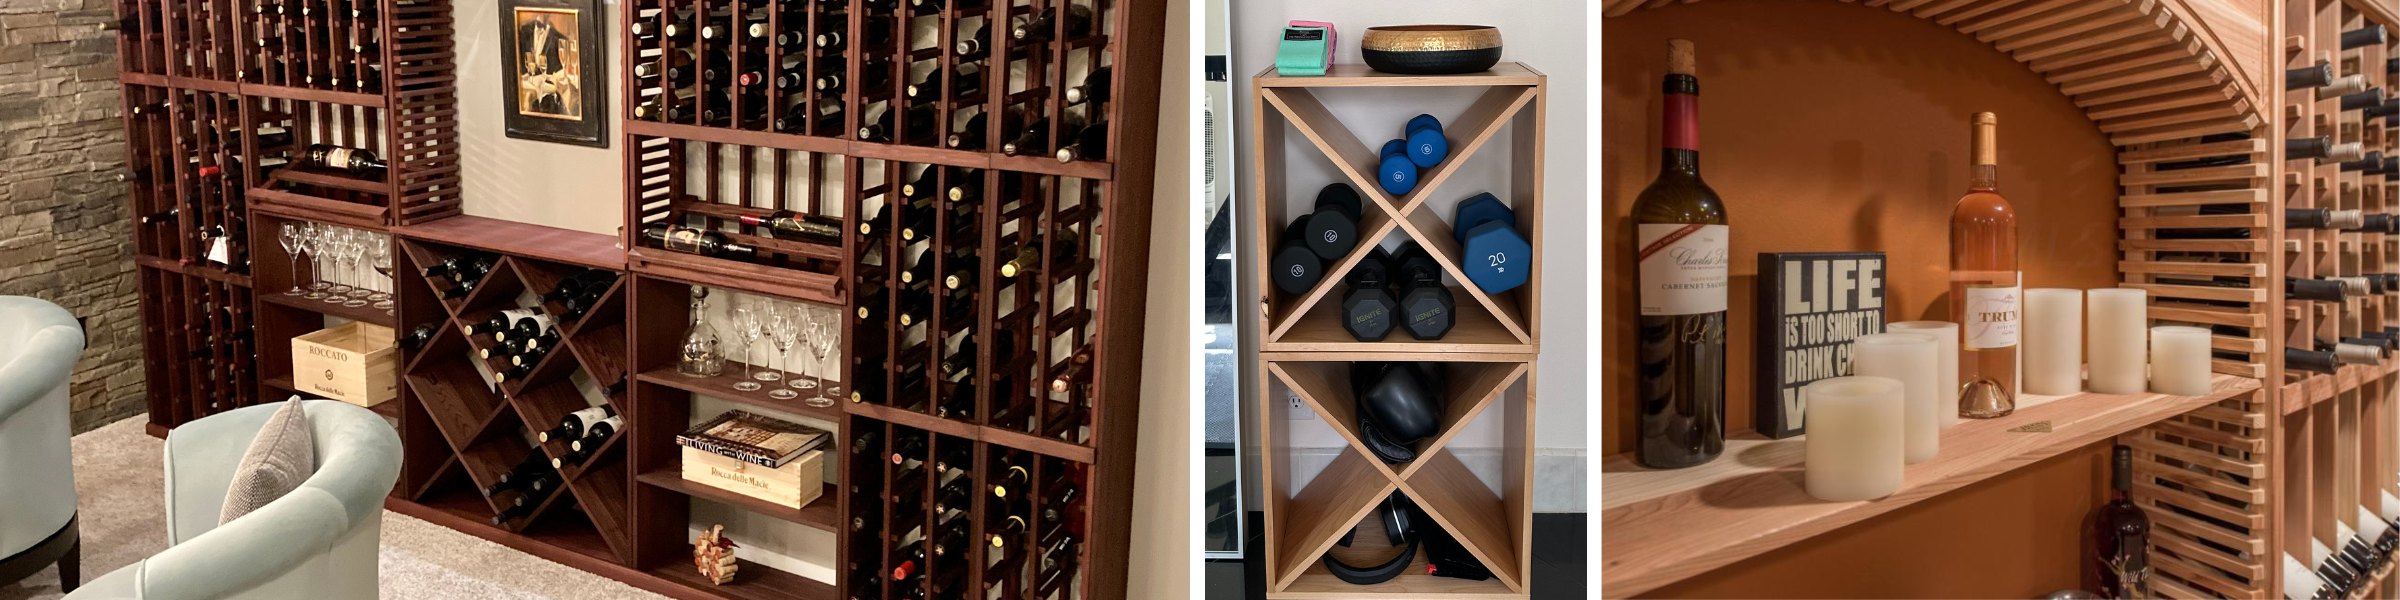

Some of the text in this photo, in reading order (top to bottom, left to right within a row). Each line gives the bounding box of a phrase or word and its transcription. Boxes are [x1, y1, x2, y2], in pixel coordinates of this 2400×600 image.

[1488, 251, 1506, 267] 20
[1661, 282, 1704, 290] CABERNET
[1785, 258, 1882, 315] LIFE
[1356, 308, 1382, 324] IGNITE
[1415, 307, 1441, 322] IGNITE
[1785, 309, 1880, 348] IS TOO SHORT TO
[309, 345, 348, 362] ROCCATO
[1785, 345, 1835, 385] DRINK
[690, 440, 723, 456] LIVING
[736, 451, 763, 465] WINE
[711, 466, 769, 489] Rocca delle Macie
